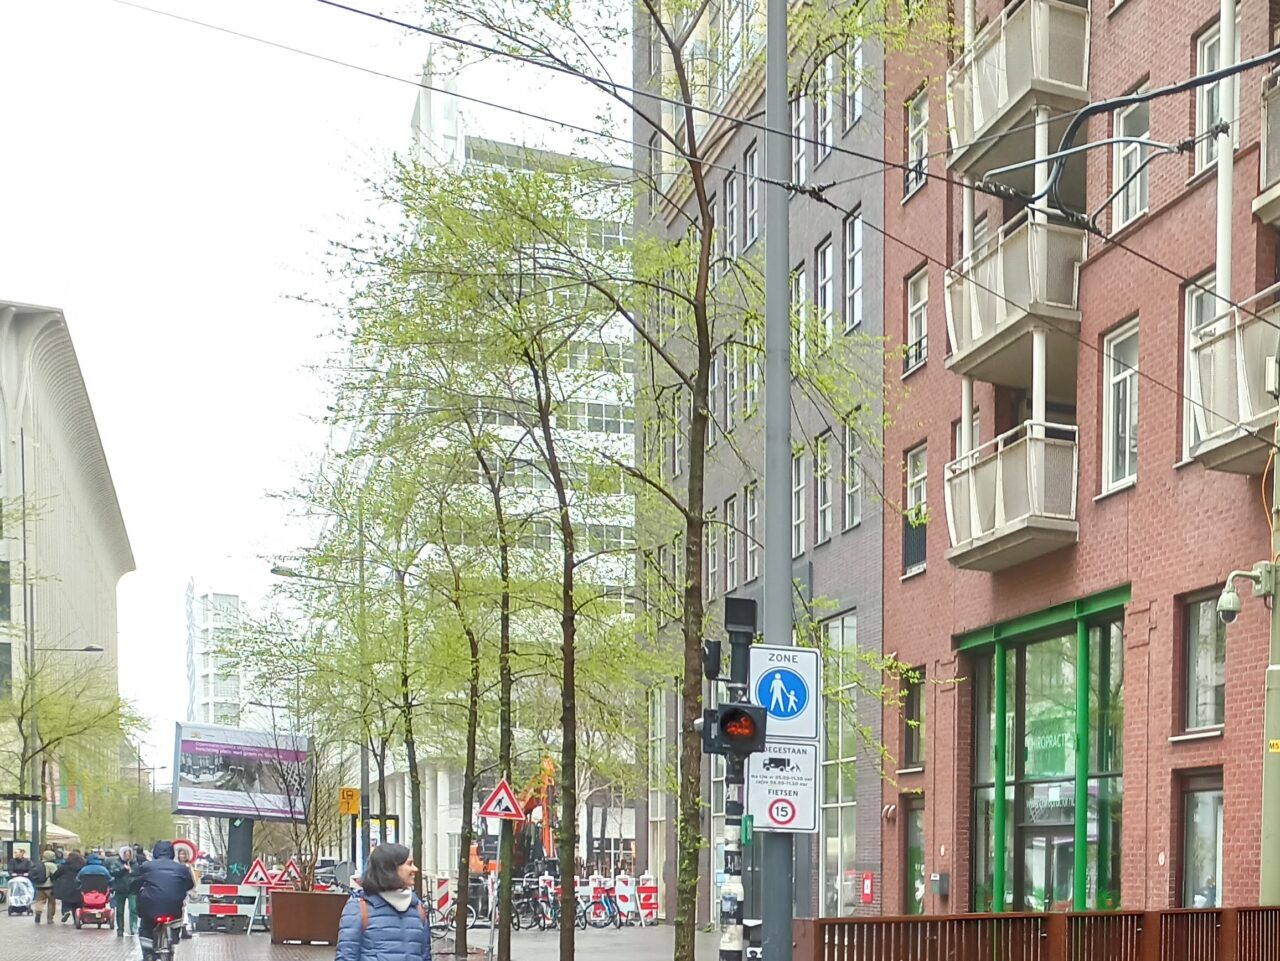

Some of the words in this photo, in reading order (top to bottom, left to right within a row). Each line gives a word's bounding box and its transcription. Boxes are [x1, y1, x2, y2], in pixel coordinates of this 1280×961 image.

[768, 653, 799, 664] ZONE
[764, 746, 808, 755] EGESTAAN
[767, 788, 799, 797] FIETSEN
[775, 806, 789, 818] 15
